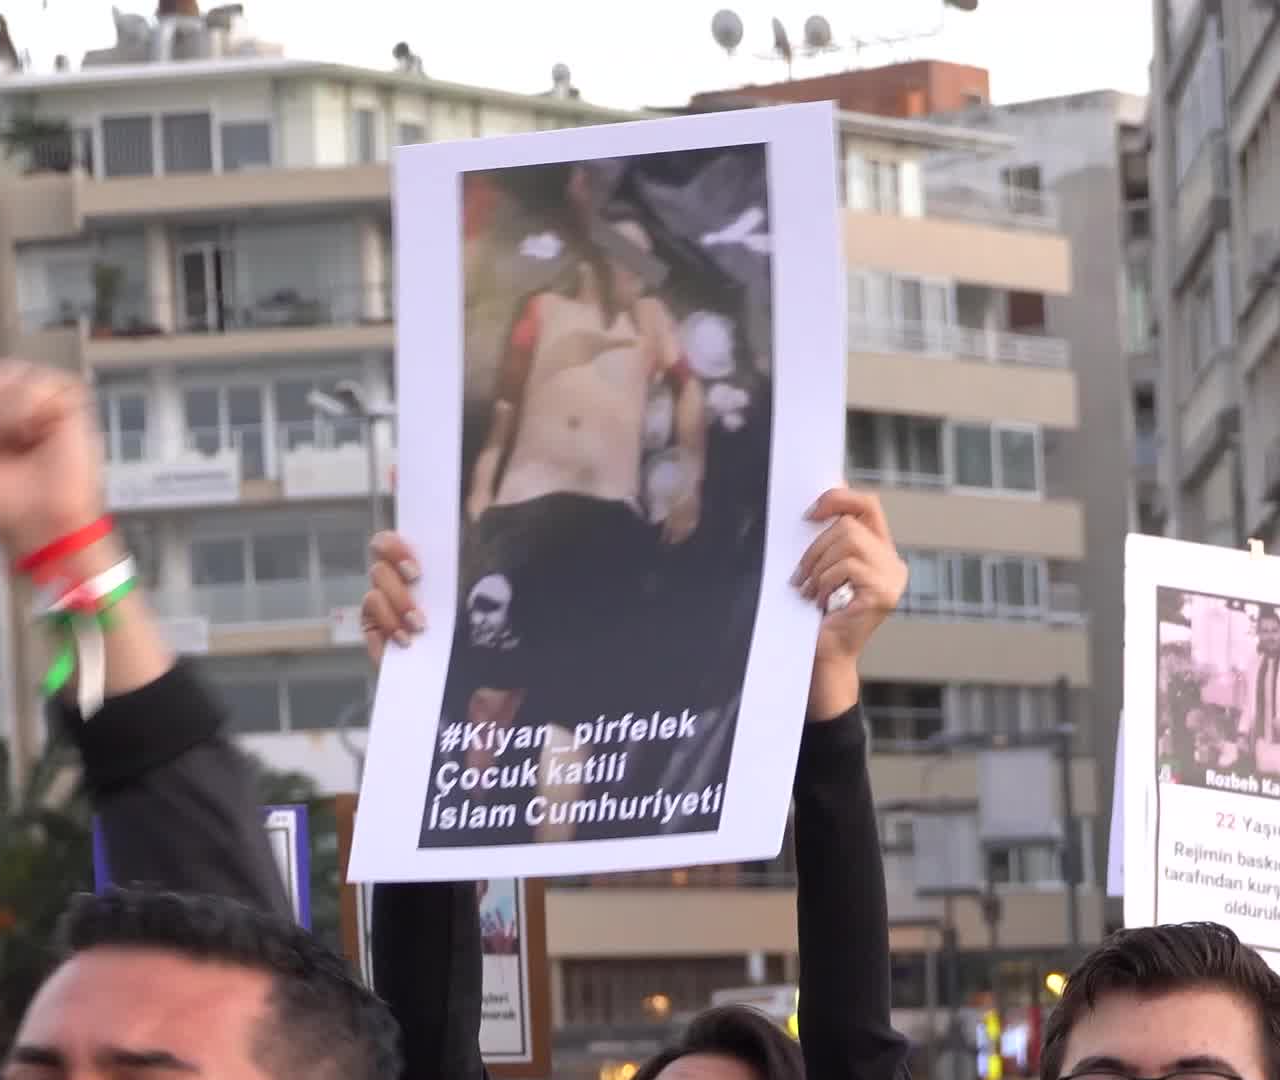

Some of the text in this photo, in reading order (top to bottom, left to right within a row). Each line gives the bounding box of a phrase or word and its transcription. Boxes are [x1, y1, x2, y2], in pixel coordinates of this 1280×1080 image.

[439, 708, 698, 757] #Kiyan_pirfelek
[434, 753, 628, 798] Çocuk katili
[524, 783, 724, 826] Cumhuriyeti
[1215, 812, 1236, 829] 22
[1174, 841, 1233, 864] Rejimin
[1165, 866, 1243, 890] tarafından
